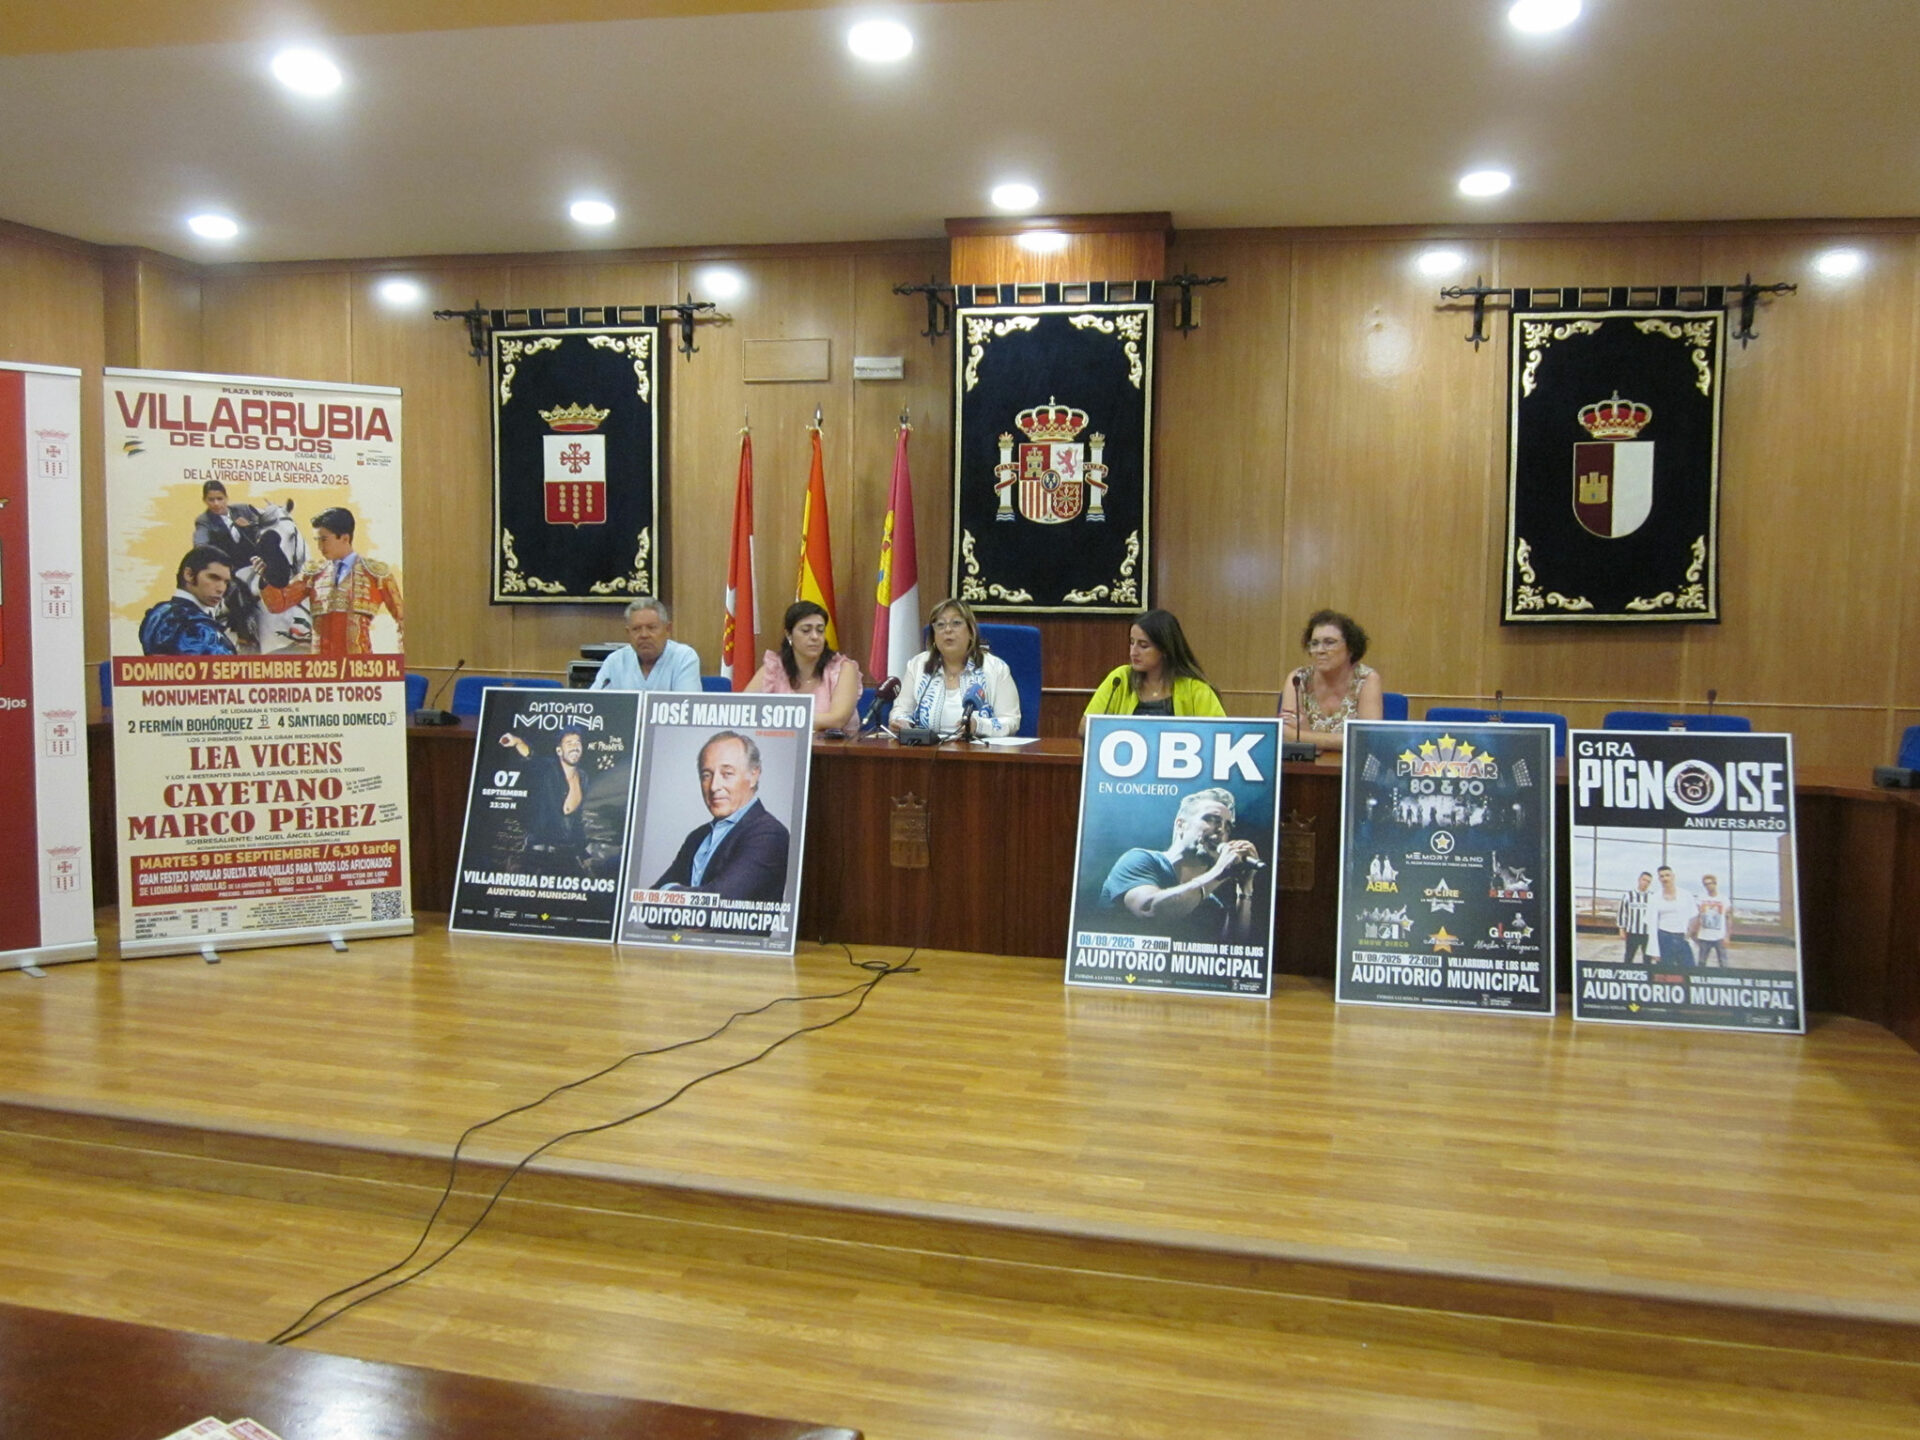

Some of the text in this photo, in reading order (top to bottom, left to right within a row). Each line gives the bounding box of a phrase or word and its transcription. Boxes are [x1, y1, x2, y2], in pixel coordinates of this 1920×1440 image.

[222, 387, 250, 395] PLAZA
[115, 390, 393, 442] VILLARRUBIA
[170, 432, 333, 453] DE LOS OJOS
[184, 468, 350, 485] DE LA VIRGEN DE LA SIERRA 2025
[211, 458, 323, 473] FIESTAS PATRONALES
[121, 657, 400, 681] DOMINGO 7 SEPTIEMBRE 2025 / 18:30 H.
[142, 685, 383, 707] MONUMENTAL CORRIDA DE TOROS
[128, 720, 136, 733] 2
[139, 716, 183, 733] FERMÍN
[186, 715, 253, 734] BOHÓRQUEZ
[278, 716, 285, 727] 4
[288, 714, 340, 727] SANTIAGO
[343, 712, 387, 726] DOMECQ
[513, 713, 604, 731] MOLINA
[650, 699, 807, 728] JOSÉ MANUEL SOTO
[189, 741, 343, 771] LEA VICENS
[1099, 729, 1265, 782] OBK
[494, 770, 521, 787] 07
[1397, 760, 1498, 779] PLAYSTAR
[163, 777, 343, 808] CAYETANO
[482, 788, 528, 798] SEPTIEMBRE
[1098, 782, 1178, 796] EN CONCIERTO
[1410, 779, 1484, 796] 80 & 90
[1578, 758, 1785, 814] PIGNOISE
[127, 810, 256, 841] MARCO
[268, 802, 377, 832] PÉREZ
[287, 831, 313, 839] ÁNGEL
[314, 830, 351, 838] SÁNCHEZ
[140, 855, 198, 870] MARTES
[201, 854, 210, 866] 9
[214, 853, 233, 866] DE
[236, 846, 320, 864] SEPTIEMBRE
[323, 844, 329, 859] /
[332, 845, 359, 858] 6,30
[362, 842, 397, 855] tarde
[1405, 852, 1484, 863] MEMORY BAND
[139, 857, 392, 885] GRAN FESTEJO POPULAR SUELTA DE VAQUILLAS PARA TODOS LOS AFICIONADOS
[463, 870, 615, 893] VILLARRUBIA DE LOS OJOS
[486, 887, 587, 901] AUDITORIO MUNICIPAL
[712, 896, 718, 906] H
[719, 899, 755, 911] VILLARRUBIA
[628, 905, 789, 932] AUDITORIO MUNICIPAL
[1075, 948, 1263, 979] AUDITORIO MUNICIPAL
[1351, 964, 1540, 993] AUDITORIO MUNICIPAL
[1582, 981, 1795, 1010] AUDITORIO MUNICIPAL
